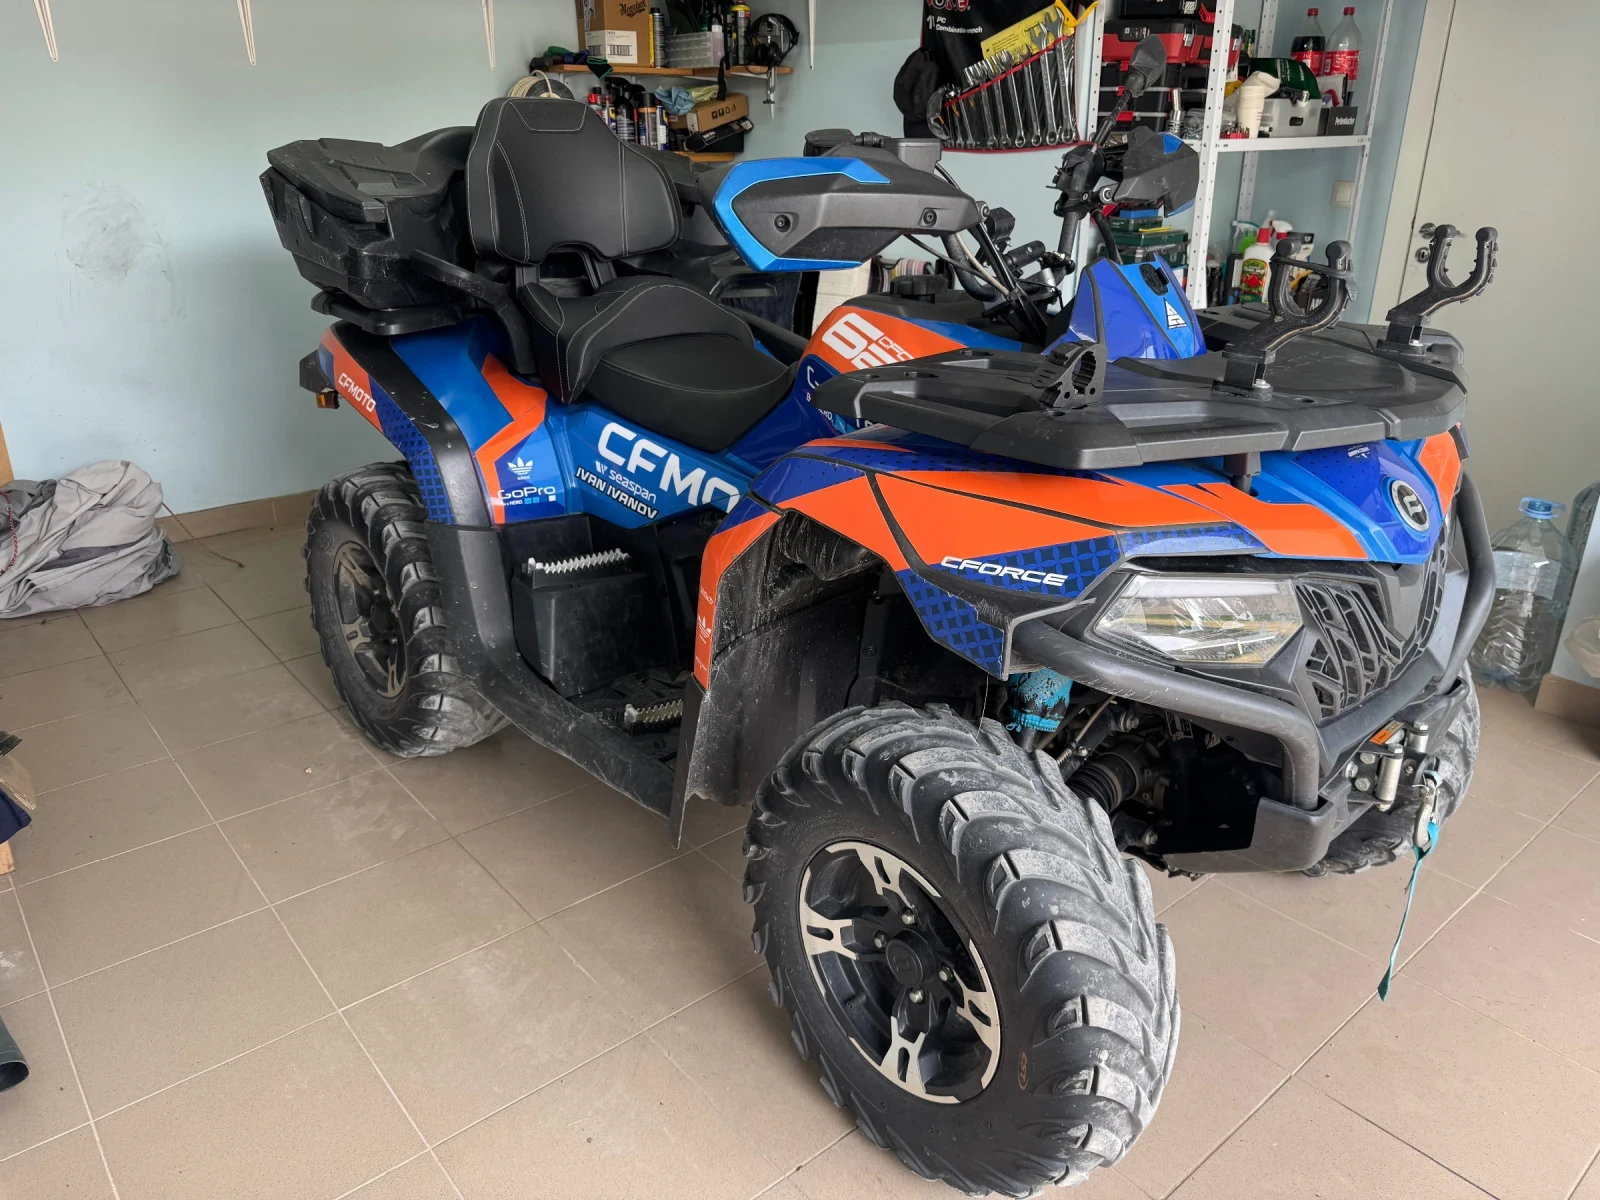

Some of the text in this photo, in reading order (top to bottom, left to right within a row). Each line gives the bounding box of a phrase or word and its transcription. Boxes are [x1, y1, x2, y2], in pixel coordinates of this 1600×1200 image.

[936, 16, 946, 24] PC
[338, 372, 376, 413] CFMOTO
[497, 486, 556, 500] GoPro
[575, 468, 659, 520] IVAN IVANOV
[609, 469, 656, 504] seaspan
[940, 555, 1068, 587] CFORCE
